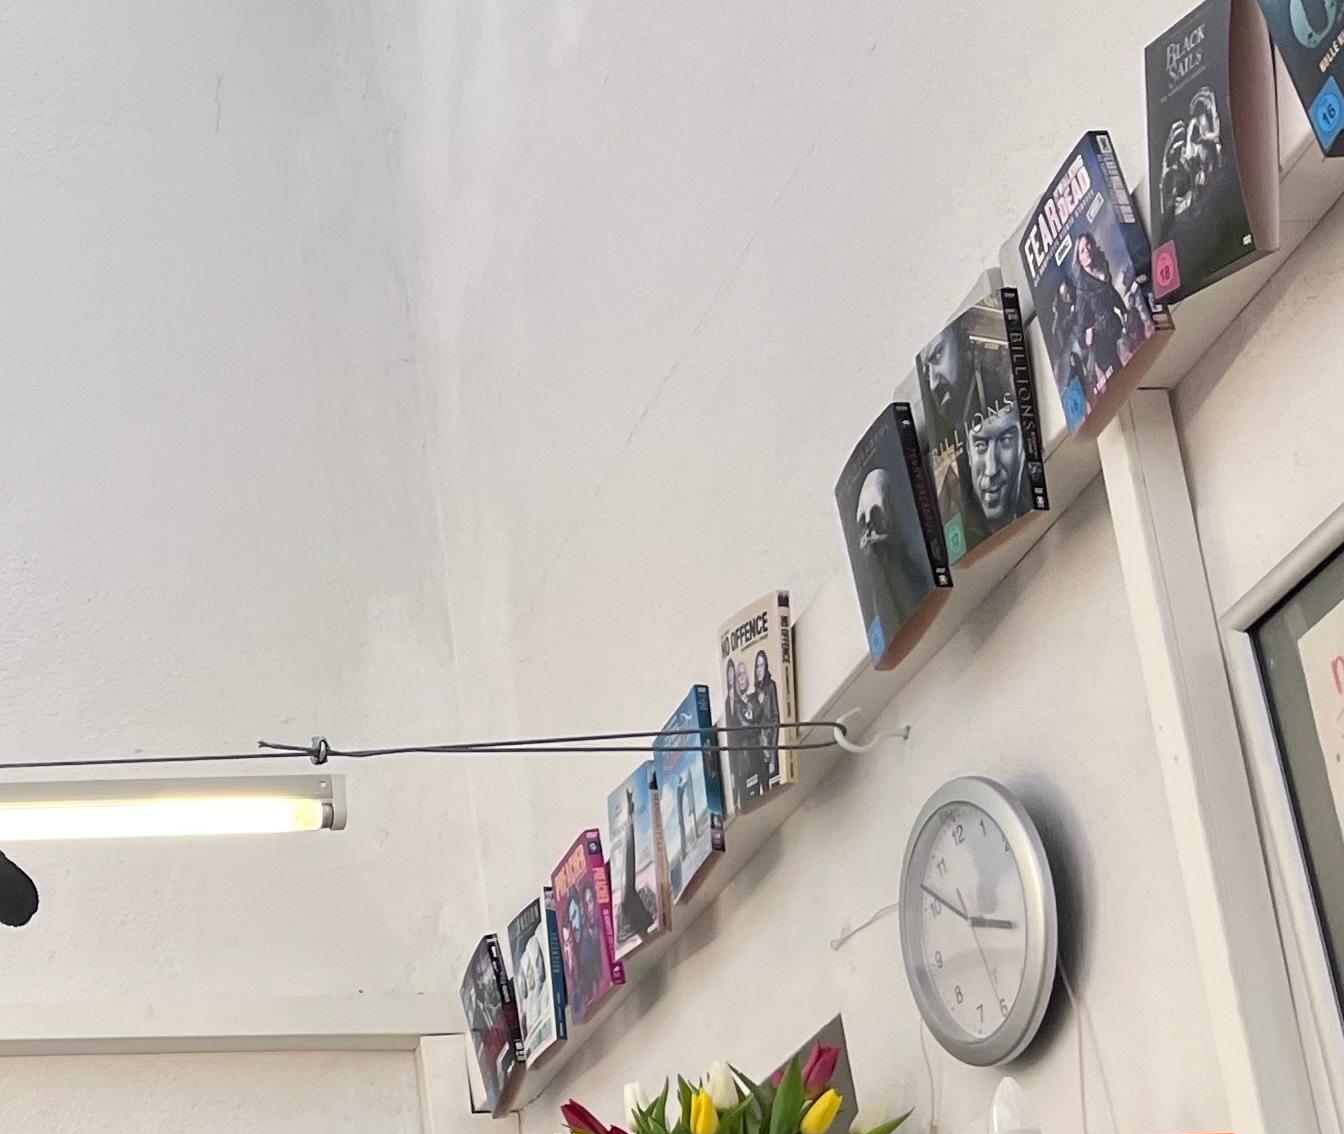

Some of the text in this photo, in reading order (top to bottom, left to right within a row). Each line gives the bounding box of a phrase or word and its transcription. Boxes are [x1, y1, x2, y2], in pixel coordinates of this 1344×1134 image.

[1166, 24, 1205, 70] BLACK
[1168, 52, 1202, 82] SAILS
[1322, 105, 1336, 126] 16
[1024, 199, 1060, 279] FEAR
[1010, 333, 1036, 431] BILLIONS
[931, 392, 1015, 457] BILLIONS
[730, 611, 769, 652] OFFENCE
[951, 824, 965, 846] 12
[980, 820, 987, 836] 1
[937, 858, 947, 877] 11
[934, 950, 944, 969] 9
[954, 985, 963, 1005] 8
[975, 1003, 984, 1023] 7
[998, 998, 1009, 1018] 6
